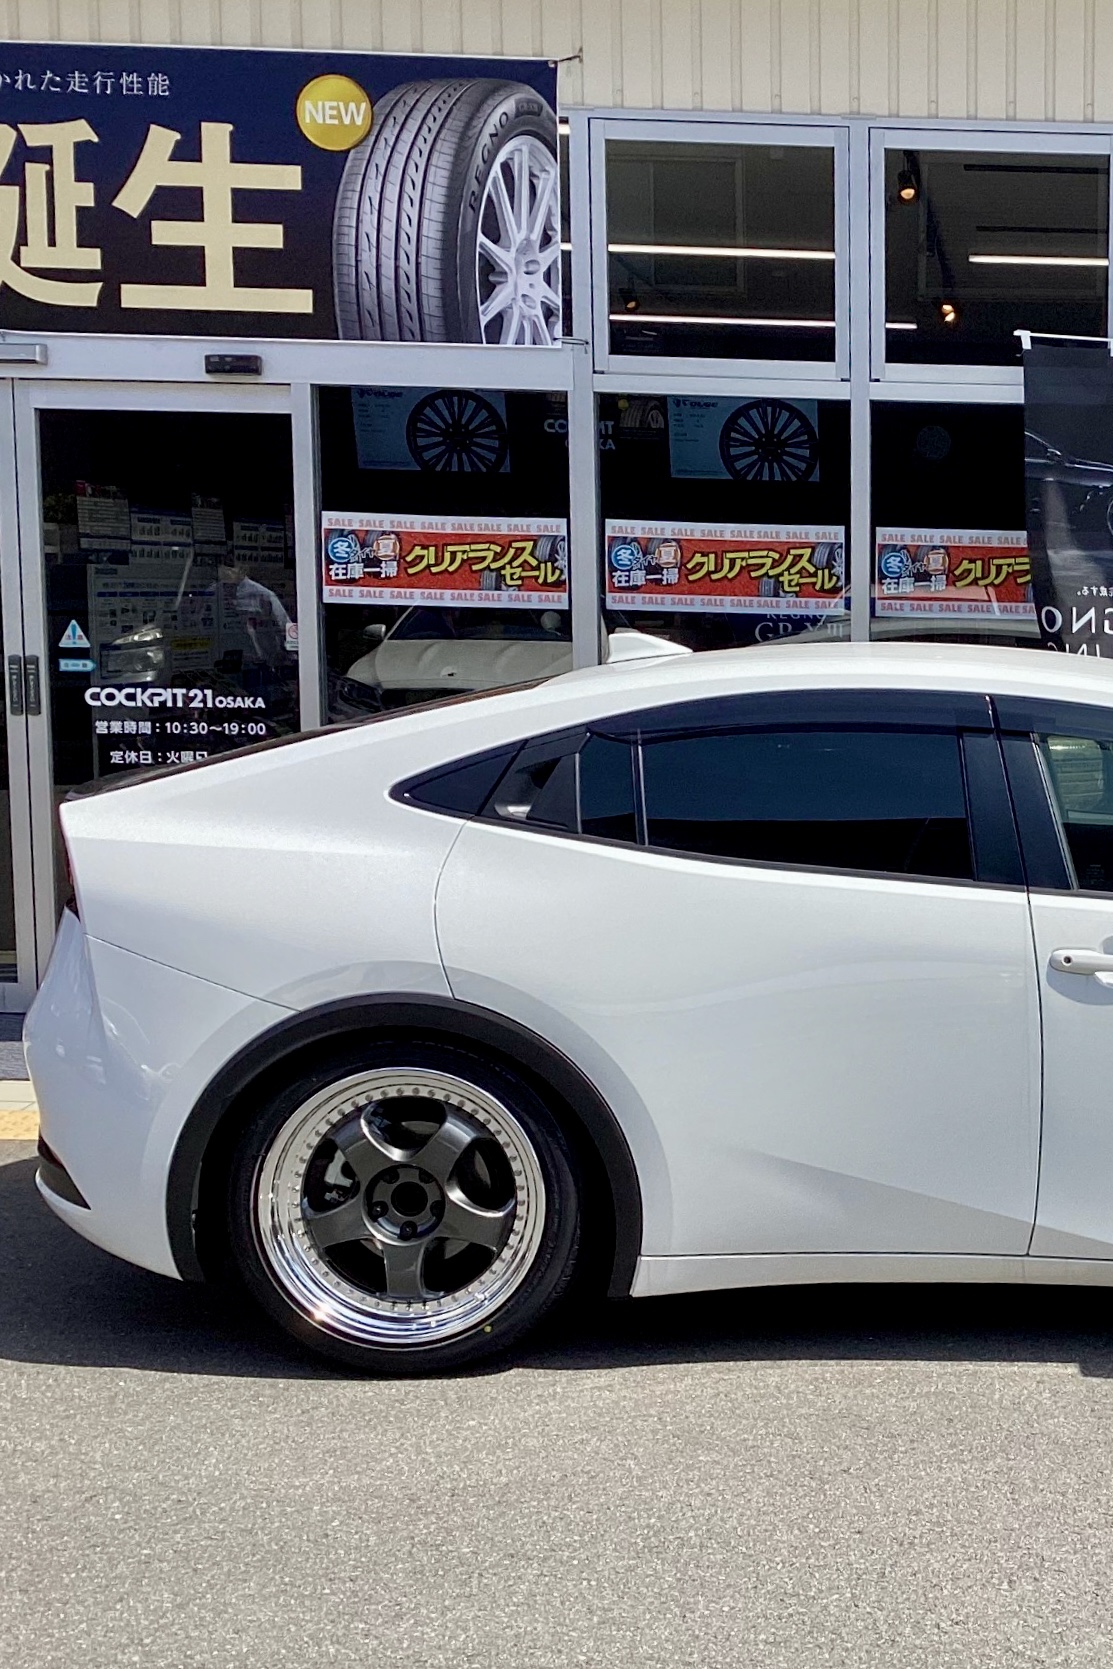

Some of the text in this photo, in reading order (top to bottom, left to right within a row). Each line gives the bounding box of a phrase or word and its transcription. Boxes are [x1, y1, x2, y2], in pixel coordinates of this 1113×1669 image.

[304, 101, 366, 125] NEW
[328, 518, 561, 533] SALE SALE SALE SALE SALE SALE SALE SALE
[611, 526, 839, 540] SALE SALE SALE SALE SALE SALE SALE SALE
[881, 533, 905, 542] SALE
[910, 534, 934, 543] SALE
[940, 535, 963, 544] SALE
[969, 536, 992, 544] SALE
[997, 537, 1021, 545] SALE
[405, 540, 538, 574] クリアランス
[686, 548, 816, 581] クリアランス
[329, 561, 398, 581] 在庫一掃
[501, 562, 561, 586] セール
[612, 568, 679, 587] 在庫一掃
[780, 568, 837, 592] セール
[882, 575, 946, 595] 在庫一掃
[329, 588, 562, 603] SALE SALE SALE SALE SALE SALE SALE SALE
[611, 596, 636, 604] SALE
[641, 596, 665, 605] SALE
[671, 597, 695, 606] SALE
[700, 597, 724, 607] SALE
[730, 598, 754, 607] SALE
[757, 599, 780, 608] SALE
[786, 600, 809, 609] SALE
[881, 602, 905, 611] SALE
[910, 603, 933, 612] SALE
[939, 604, 962, 612] SALE
[968, 605, 991, 613] SALE
[84, 687, 266, 709] COCKPIT 21 OSAKA
